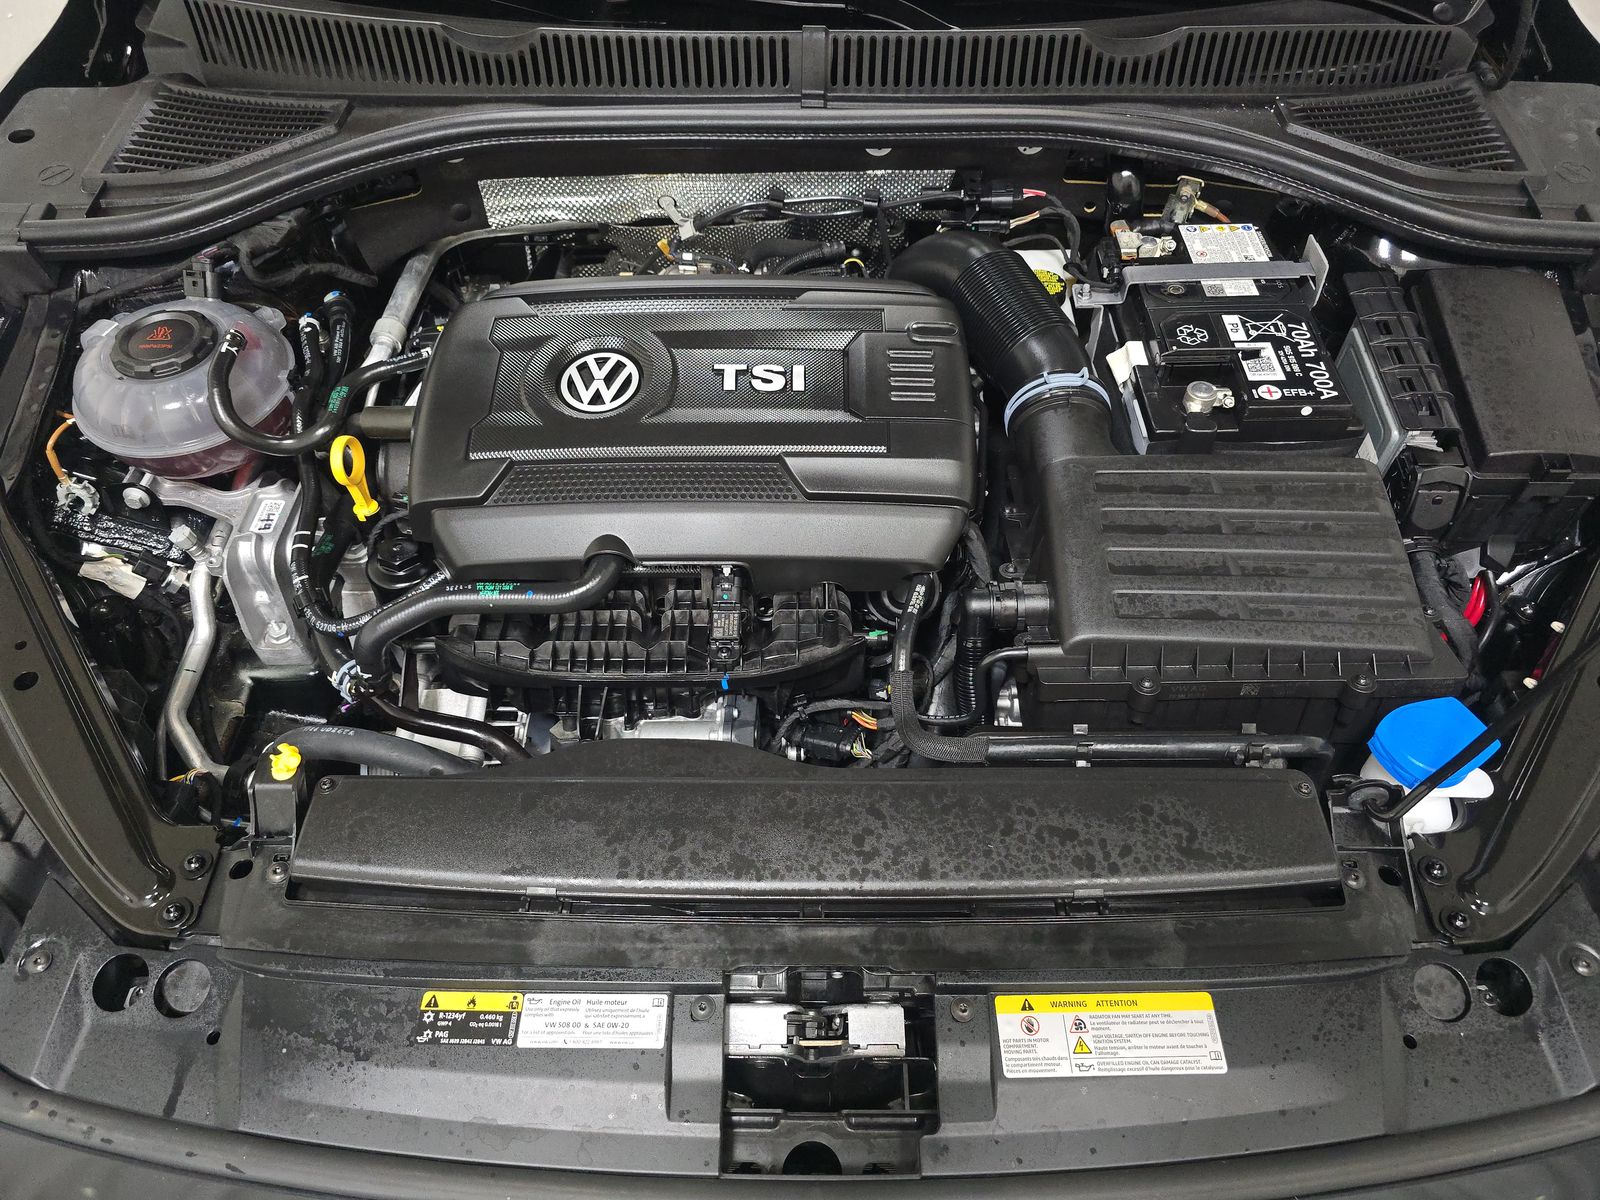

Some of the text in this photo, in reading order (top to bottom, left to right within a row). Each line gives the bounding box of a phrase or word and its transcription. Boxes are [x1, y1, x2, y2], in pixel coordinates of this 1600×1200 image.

[1228, 323, 1238, 333] Pb
[1288, 322, 1338, 400] 70Ah 700A
[713, 364, 806, 392] TSI
[1282, 388, 1316, 396] EFB+
[438, 1012, 466, 1021] R-1234yf
